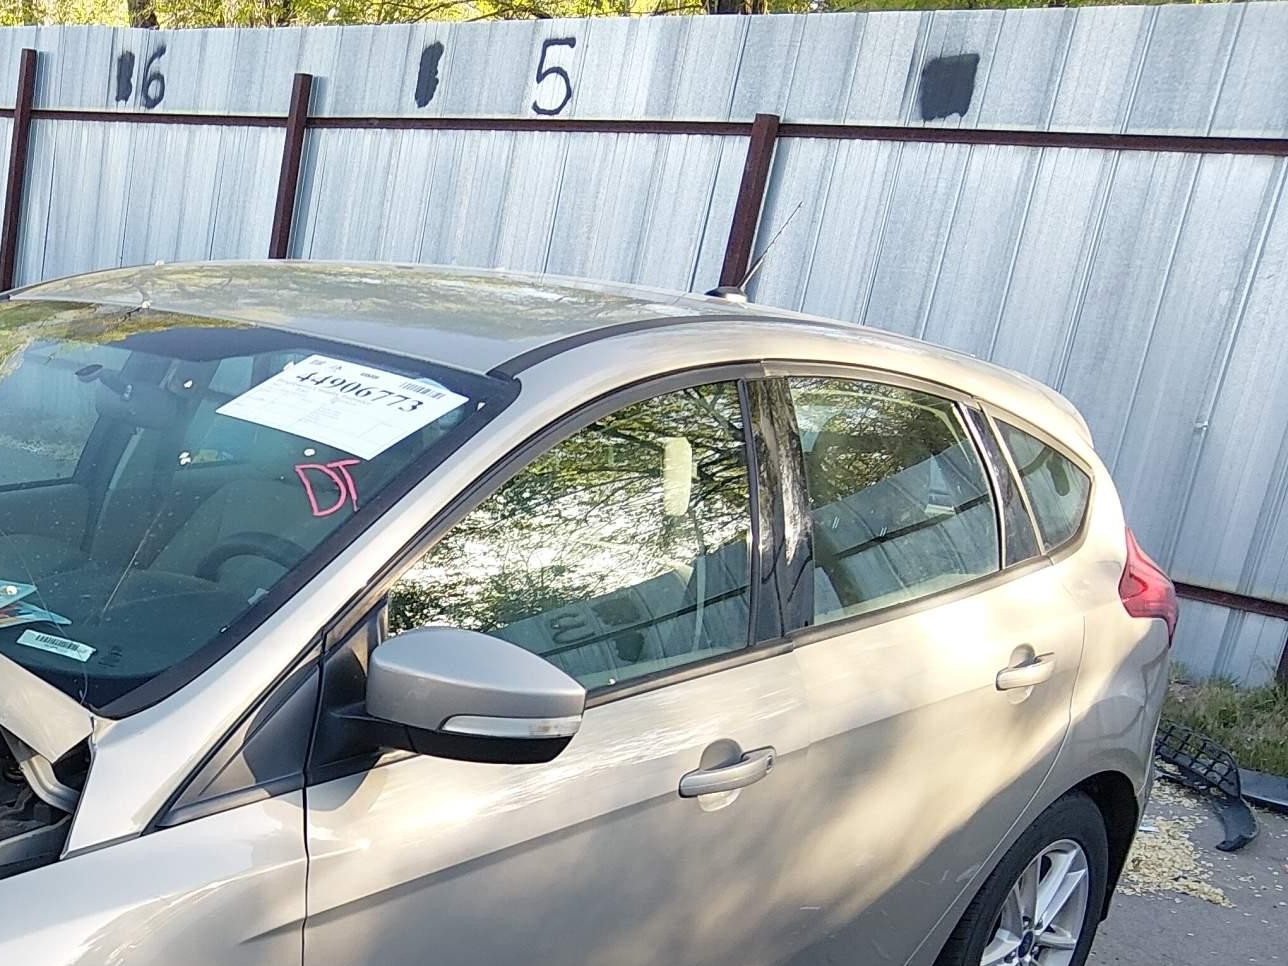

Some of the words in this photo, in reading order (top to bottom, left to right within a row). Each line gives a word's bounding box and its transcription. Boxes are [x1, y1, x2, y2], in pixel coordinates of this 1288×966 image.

[141, 44, 167, 109] 6
[532, 37, 576, 115] 5
[296, 371, 424, 412] 44906773
[295, 459, 360, 516] DT
